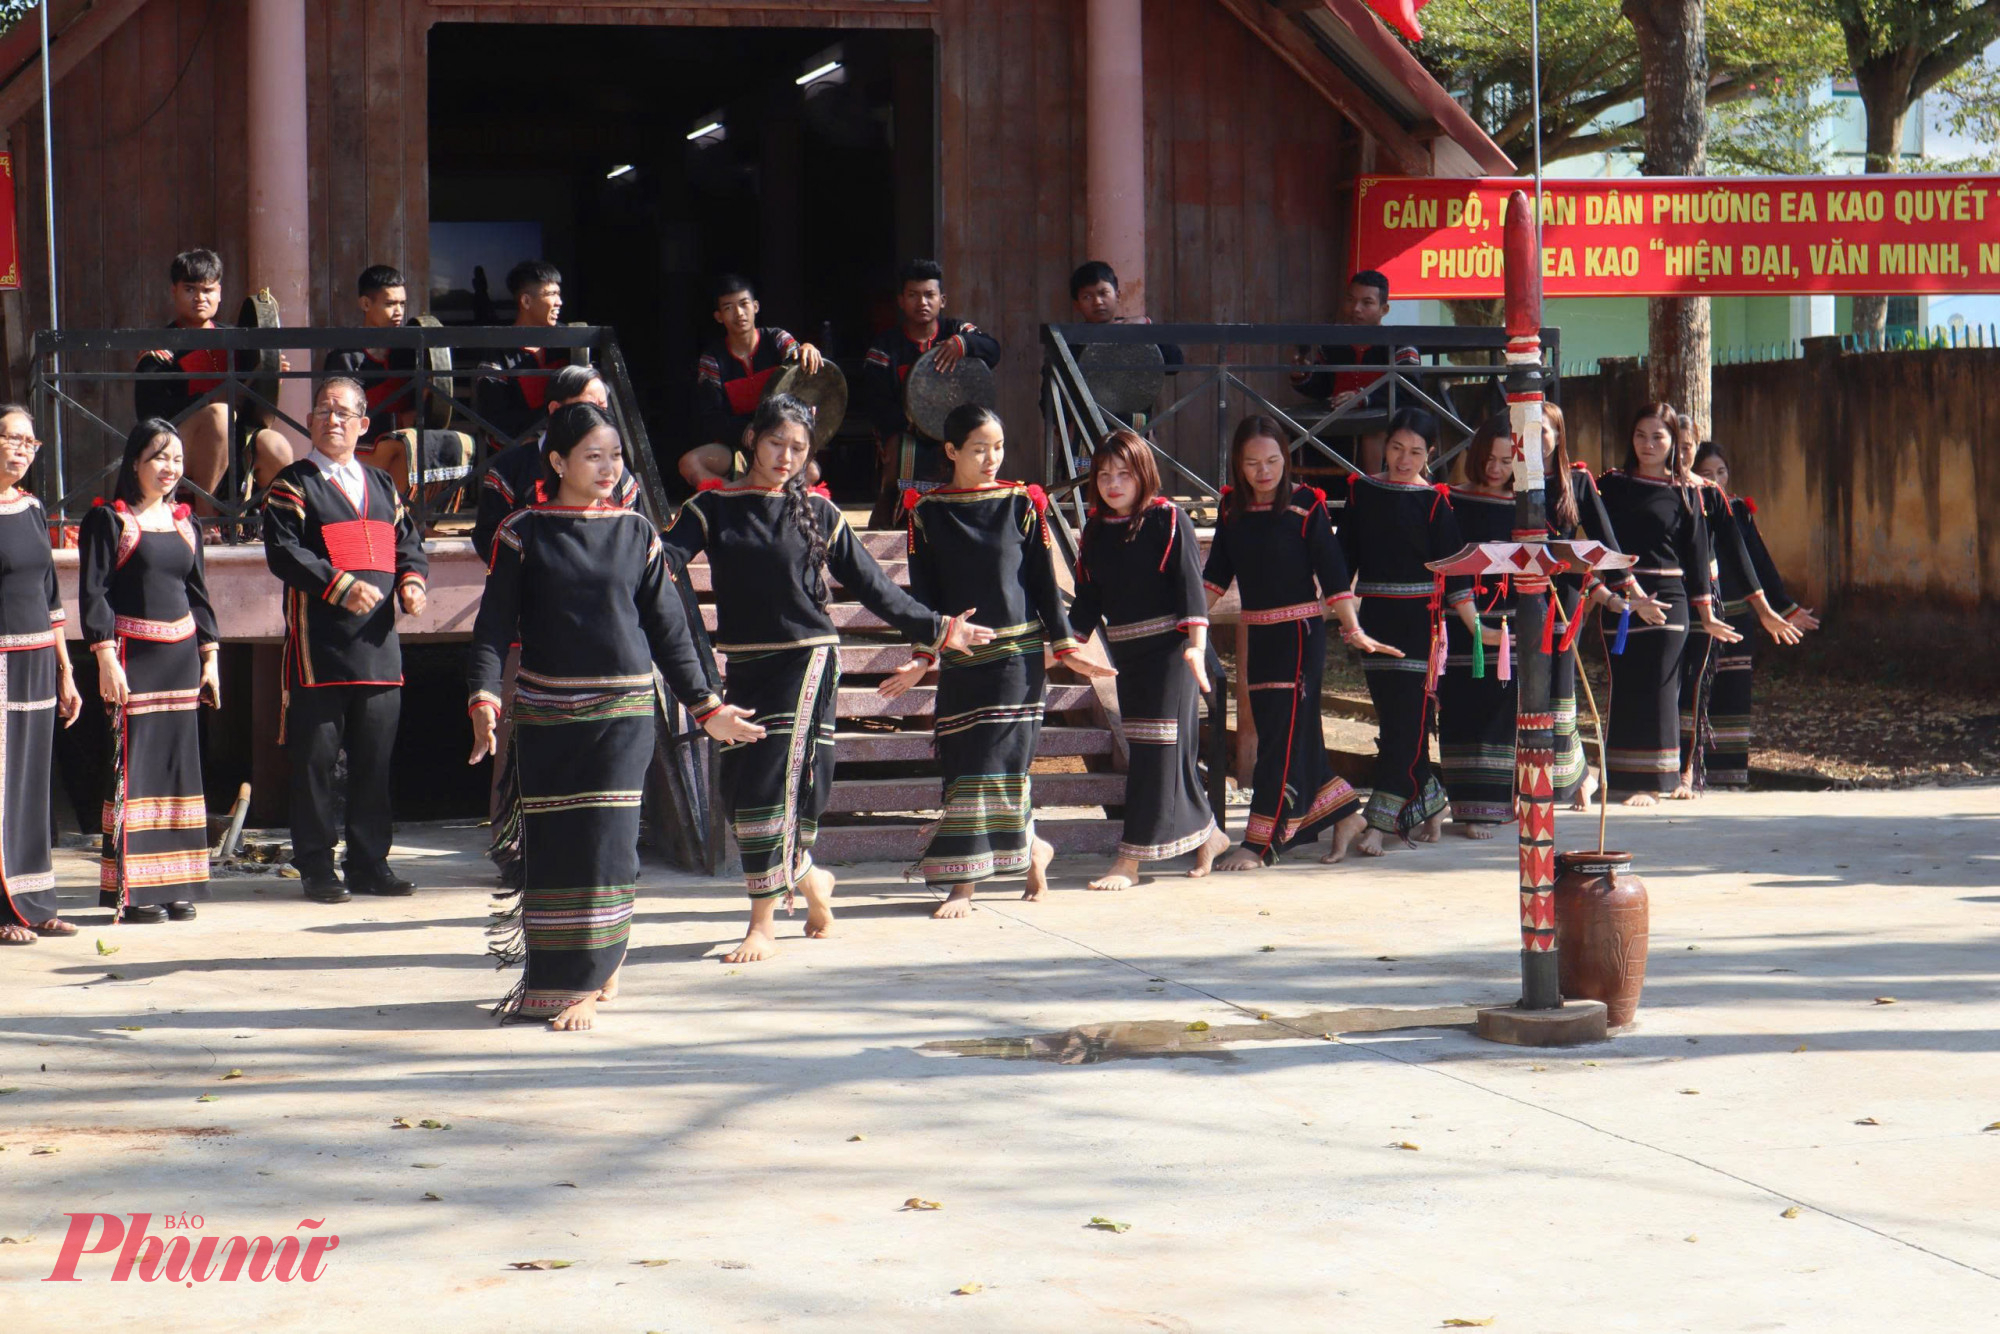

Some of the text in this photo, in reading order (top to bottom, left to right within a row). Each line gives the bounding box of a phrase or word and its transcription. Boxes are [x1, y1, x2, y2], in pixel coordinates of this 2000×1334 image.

[1383, 193, 1438, 229] CÁN
[1446, 191, 1490, 234] BỘ,
[1585, 188, 1643, 225] DÂN
[1652, 187, 1770, 224] PHƯỜNG
[1780, 191, 1818, 223] EA
[1827, 190, 1885, 223] KAO
[1894, 181, 1988, 225] QUYẾT
[1420, 242, 1505, 279] PHƯỜN
[1541, 247, 1576, 278] EA
[1585, 246, 1640, 277] KAO
[1649, 237, 1733, 283] “HIỆN
[1741, 244, 1799, 282] ĐẠI,
[1808, 237, 1869, 275] VĂN
[1879, 243, 1968, 278] MINH,
